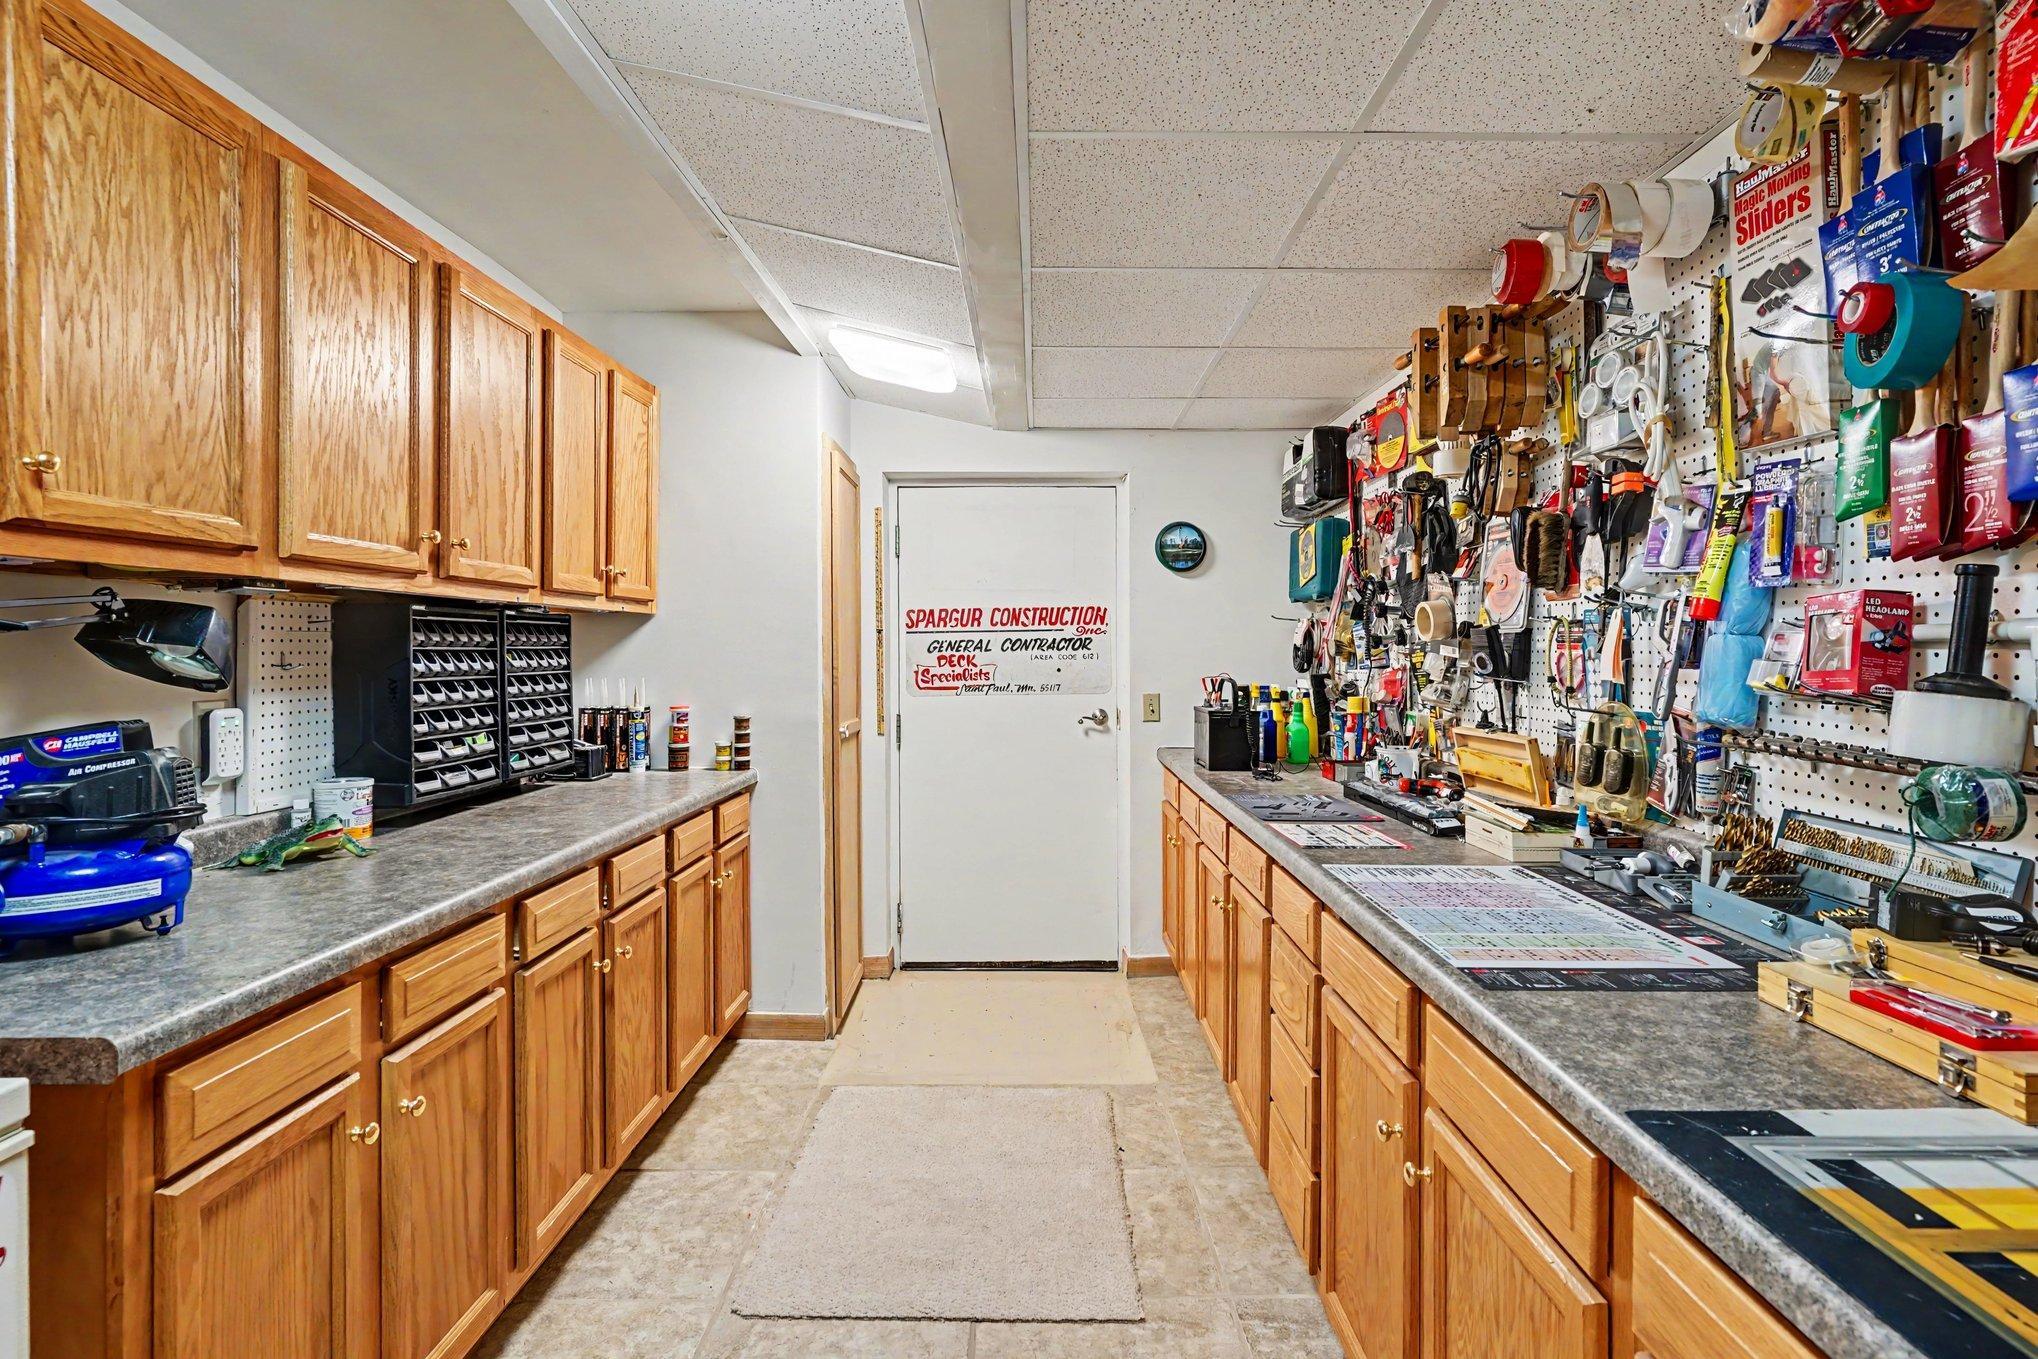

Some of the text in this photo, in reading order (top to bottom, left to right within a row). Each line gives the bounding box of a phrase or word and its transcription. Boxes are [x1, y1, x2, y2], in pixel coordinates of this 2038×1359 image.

[1827, 132, 1839, 207] HaulMaster
[1734, 162, 1811, 217] Magic Moving
[1735, 185, 1811, 246] Sliders
[1865, 597, 1881, 605] LED
[905, 605, 1109, 629] SPARGUR CONSTRUCTION,
[1865, 605, 1910, 616] HEADLAMP
[1072, 626, 1107, 636] Inc.
[927, 637, 1093, 654] GENERAL CONTRACTOR
[936, 655, 978, 668] DECK
[1082, 652, 1099, 660] 612)
[920, 668, 990, 685] Specialists
